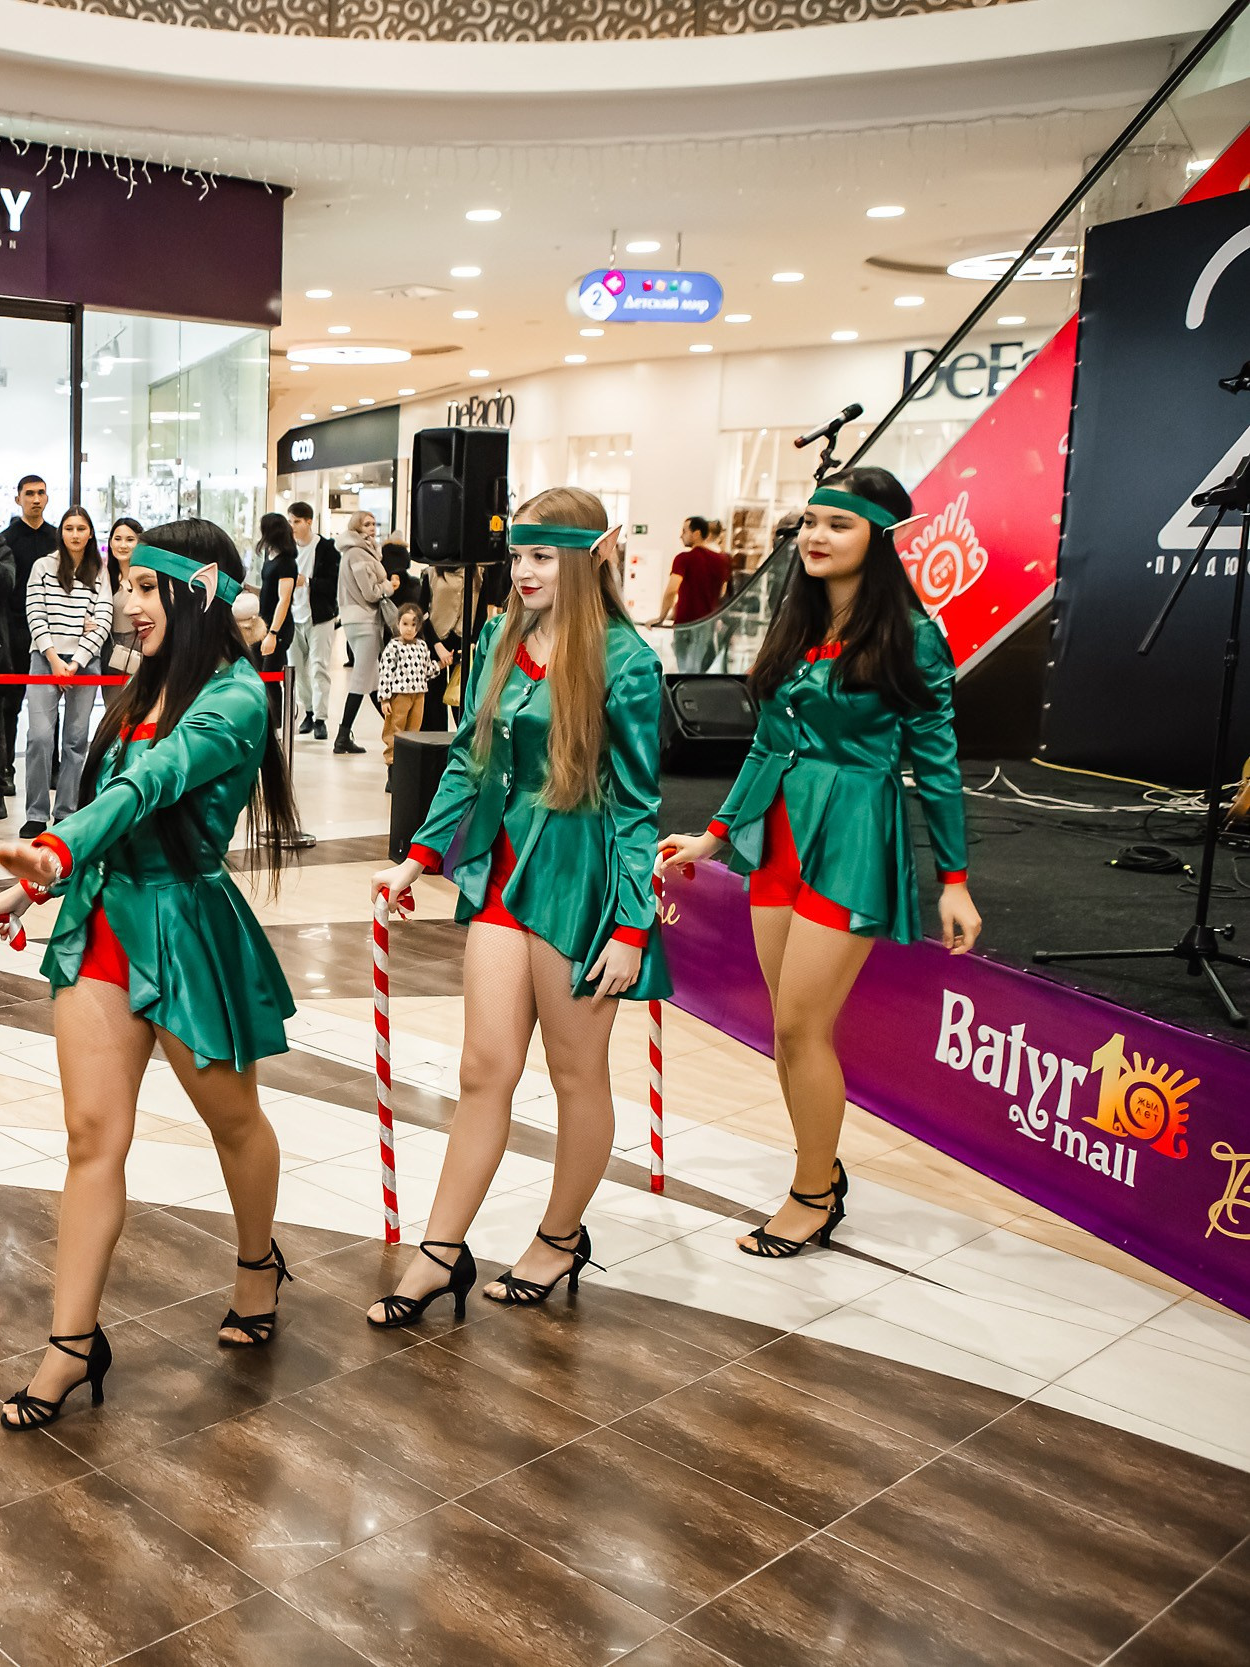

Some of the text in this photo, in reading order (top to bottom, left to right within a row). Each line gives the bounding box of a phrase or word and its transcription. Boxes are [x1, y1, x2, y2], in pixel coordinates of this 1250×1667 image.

[592, 290, 602, 305] 2
[902, 342, 1041, 401] DeF
[935, 988, 1089, 1141] Batyr
[1051, 1121, 1138, 1188] mall
